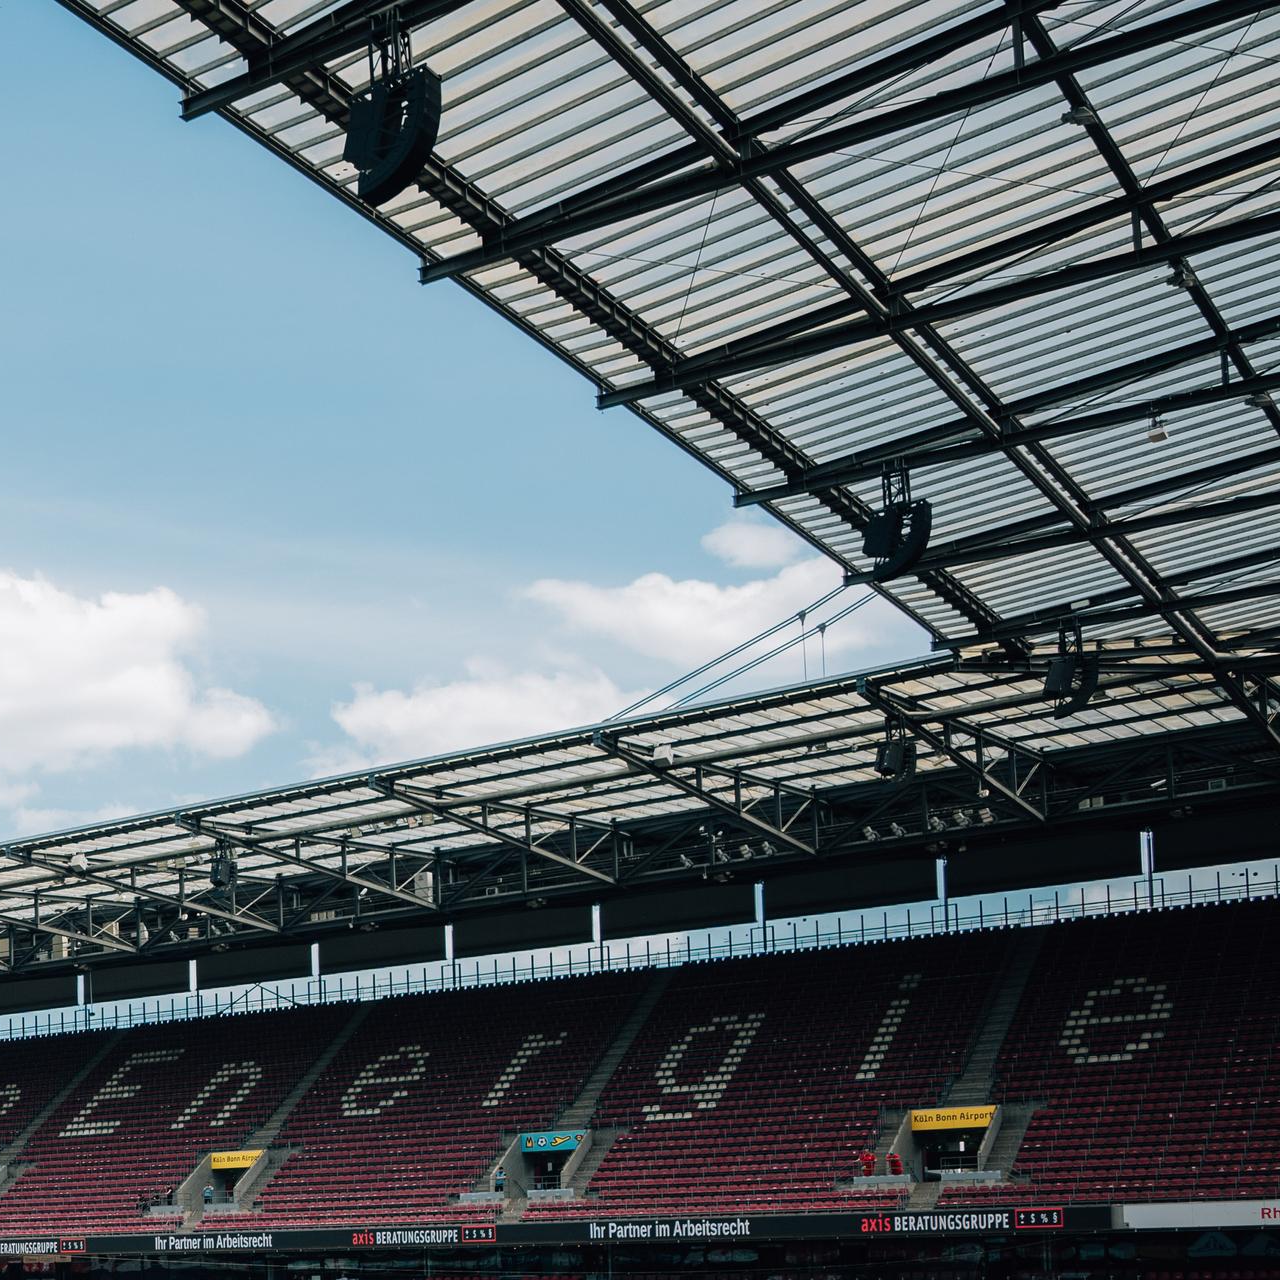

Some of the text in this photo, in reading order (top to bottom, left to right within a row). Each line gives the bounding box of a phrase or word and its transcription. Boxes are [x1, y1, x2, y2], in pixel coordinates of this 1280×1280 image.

[914, 1111, 993, 1124] Köln Bonn Airport
[861, 1212, 1009, 1232] axis BERATUNGSGRUPPE
[1040, 1213, 1049, 1224] %
[1052, 1212, 1058, 1224] §
[590, 1218, 750, 1239] Ihr Partner im Arbeitsrecht
[155, 1233, 272, 1250] Ihr Partner im Arbeitsrecht
[352, 1229, 459, 1246] axis BERATUNGSGRUPPE
